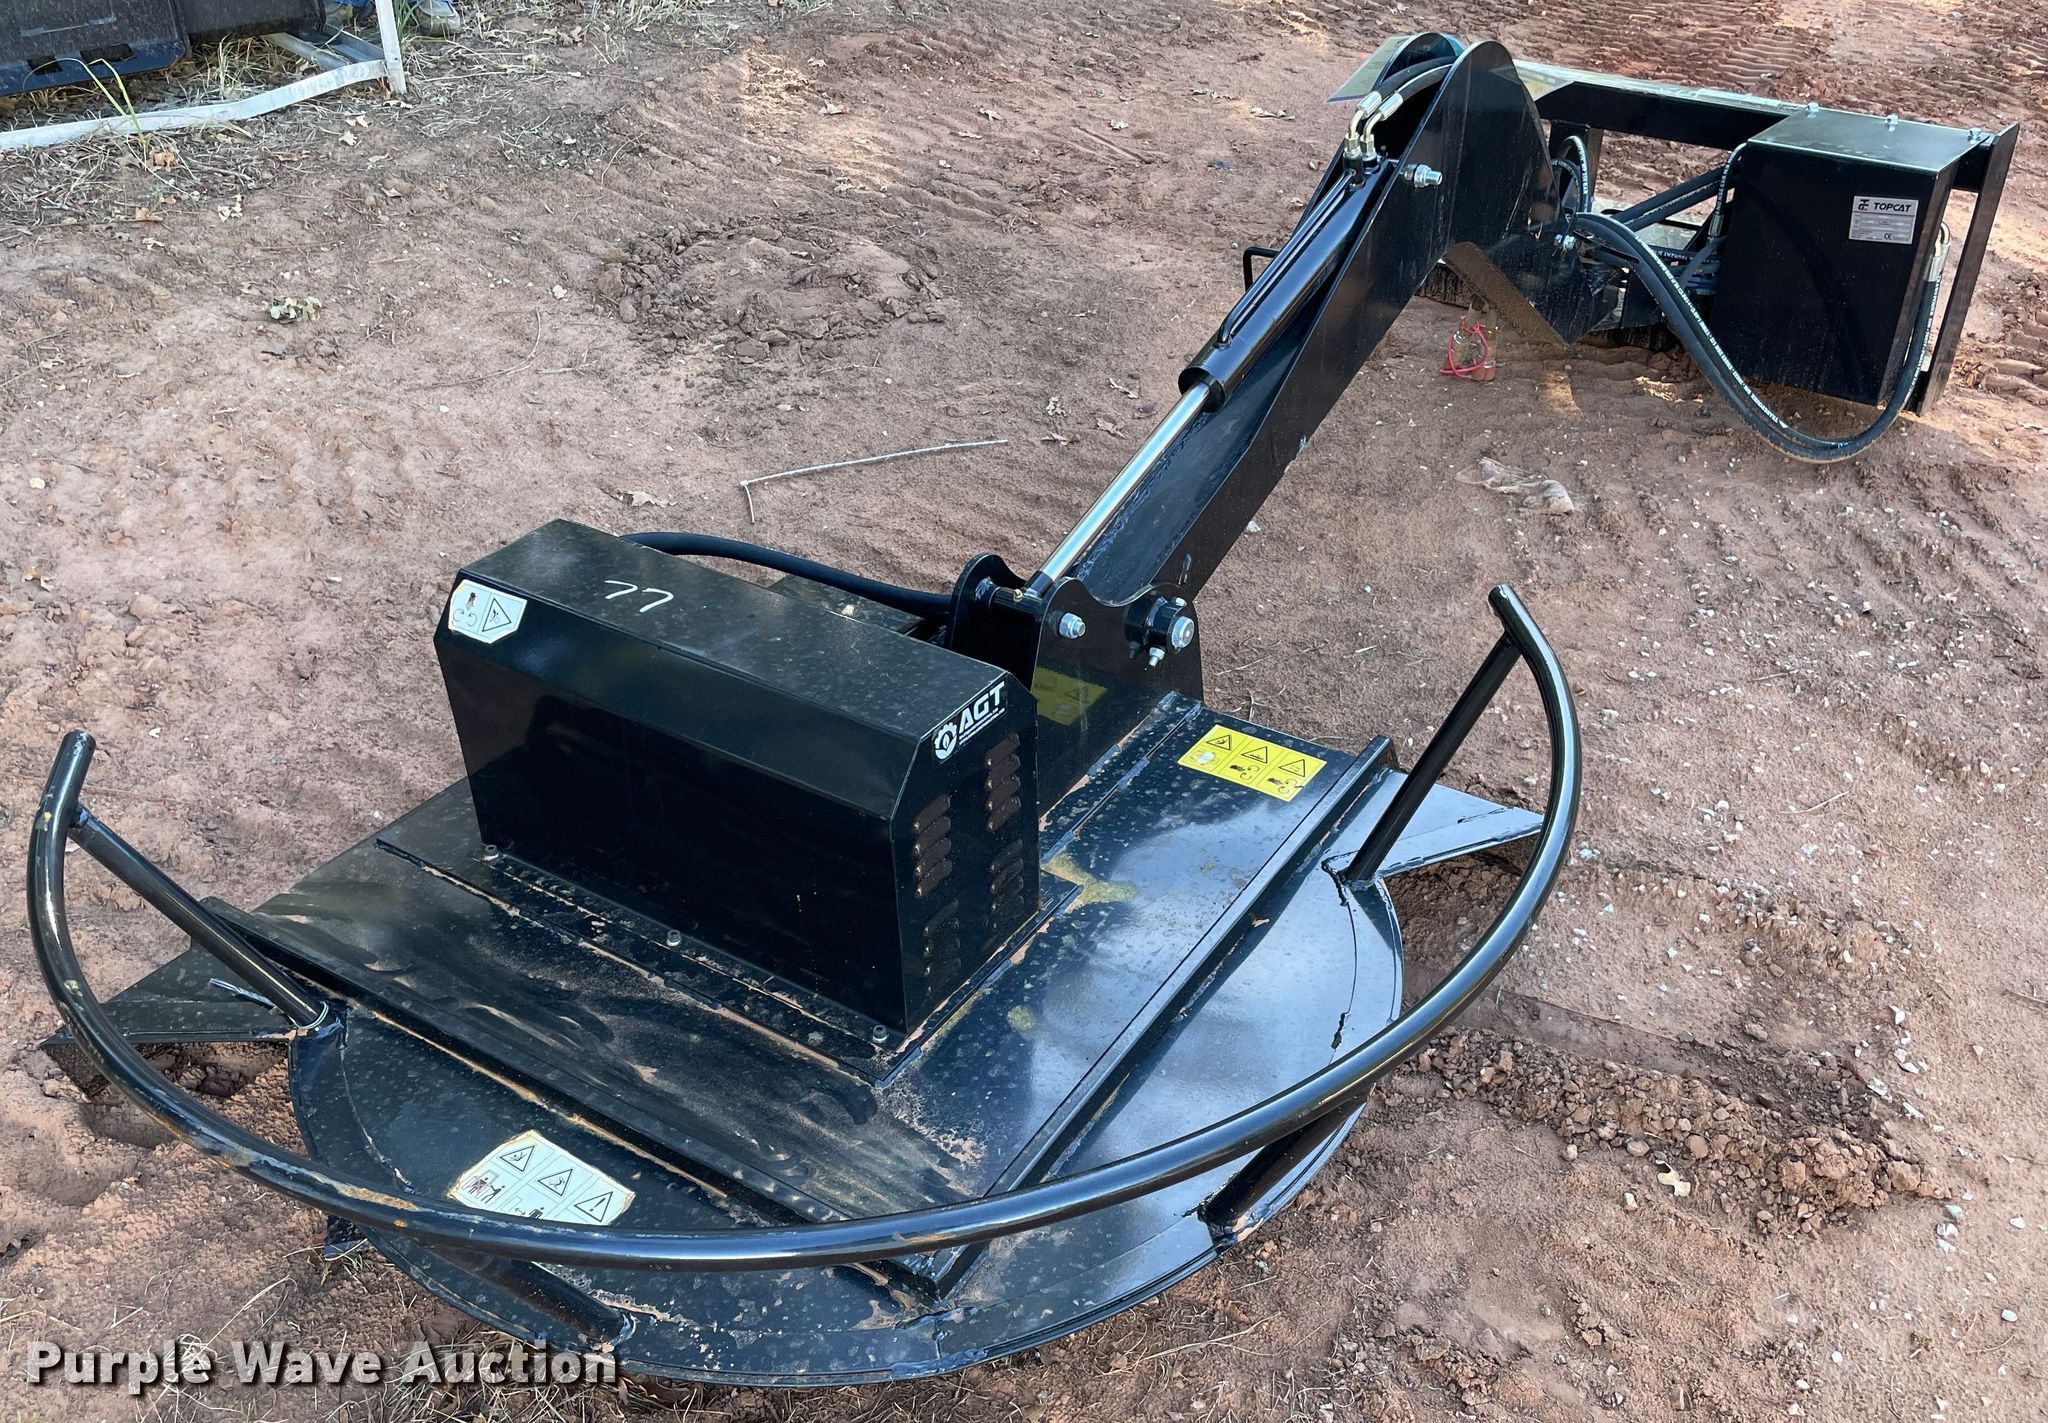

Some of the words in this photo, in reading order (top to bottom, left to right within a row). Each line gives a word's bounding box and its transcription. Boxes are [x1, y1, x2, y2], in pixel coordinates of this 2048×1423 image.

[1873, 202, 1912, 213] TOPCAT
[604, 580, 674, 613] 77
[959, 681, 1005, 734] AGT
